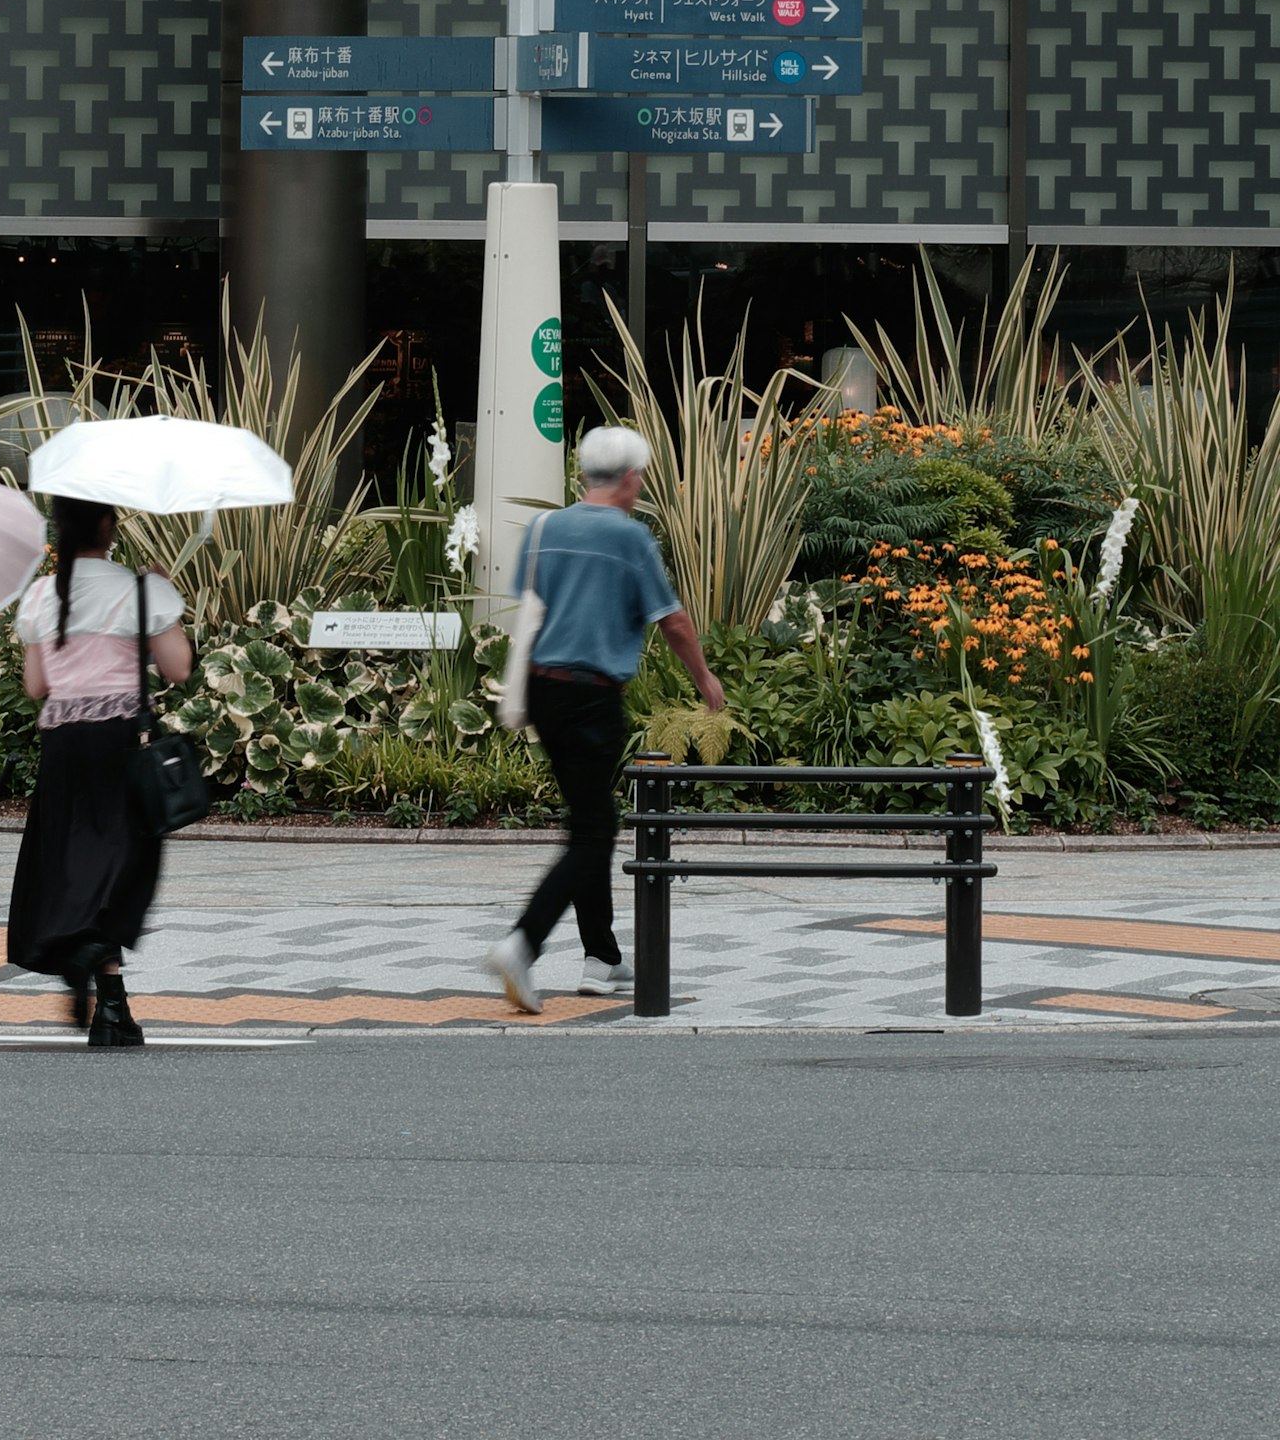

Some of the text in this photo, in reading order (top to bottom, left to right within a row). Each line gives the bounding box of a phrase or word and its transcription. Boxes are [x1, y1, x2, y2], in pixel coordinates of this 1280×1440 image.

[777, 1, 801, 9] WEST
[624, 10, 654, 22] Hyatt
[709, 12, 766, 23] West Walk
[777, 9, 801, 17] WALK
[287, 46, 352, 64] 麻布十番
[633, 50, 672, 64] シネマ
[685, 49, 768, 66] ヒルサイド
[780, 60, 799, 68] HILL
[630, 69, 672, 81] Cinema
[721, 70, 767, 82] Hillside
[780, 68, 799, 76] SIDE
[317, 106, 400, 124] 麻布十番駅
[653, 108, 722, 126] 乃木坂駅
[383, 127, 402, 139] Sta.
[652, 128, 722, 144] Nogizaka Sta.
